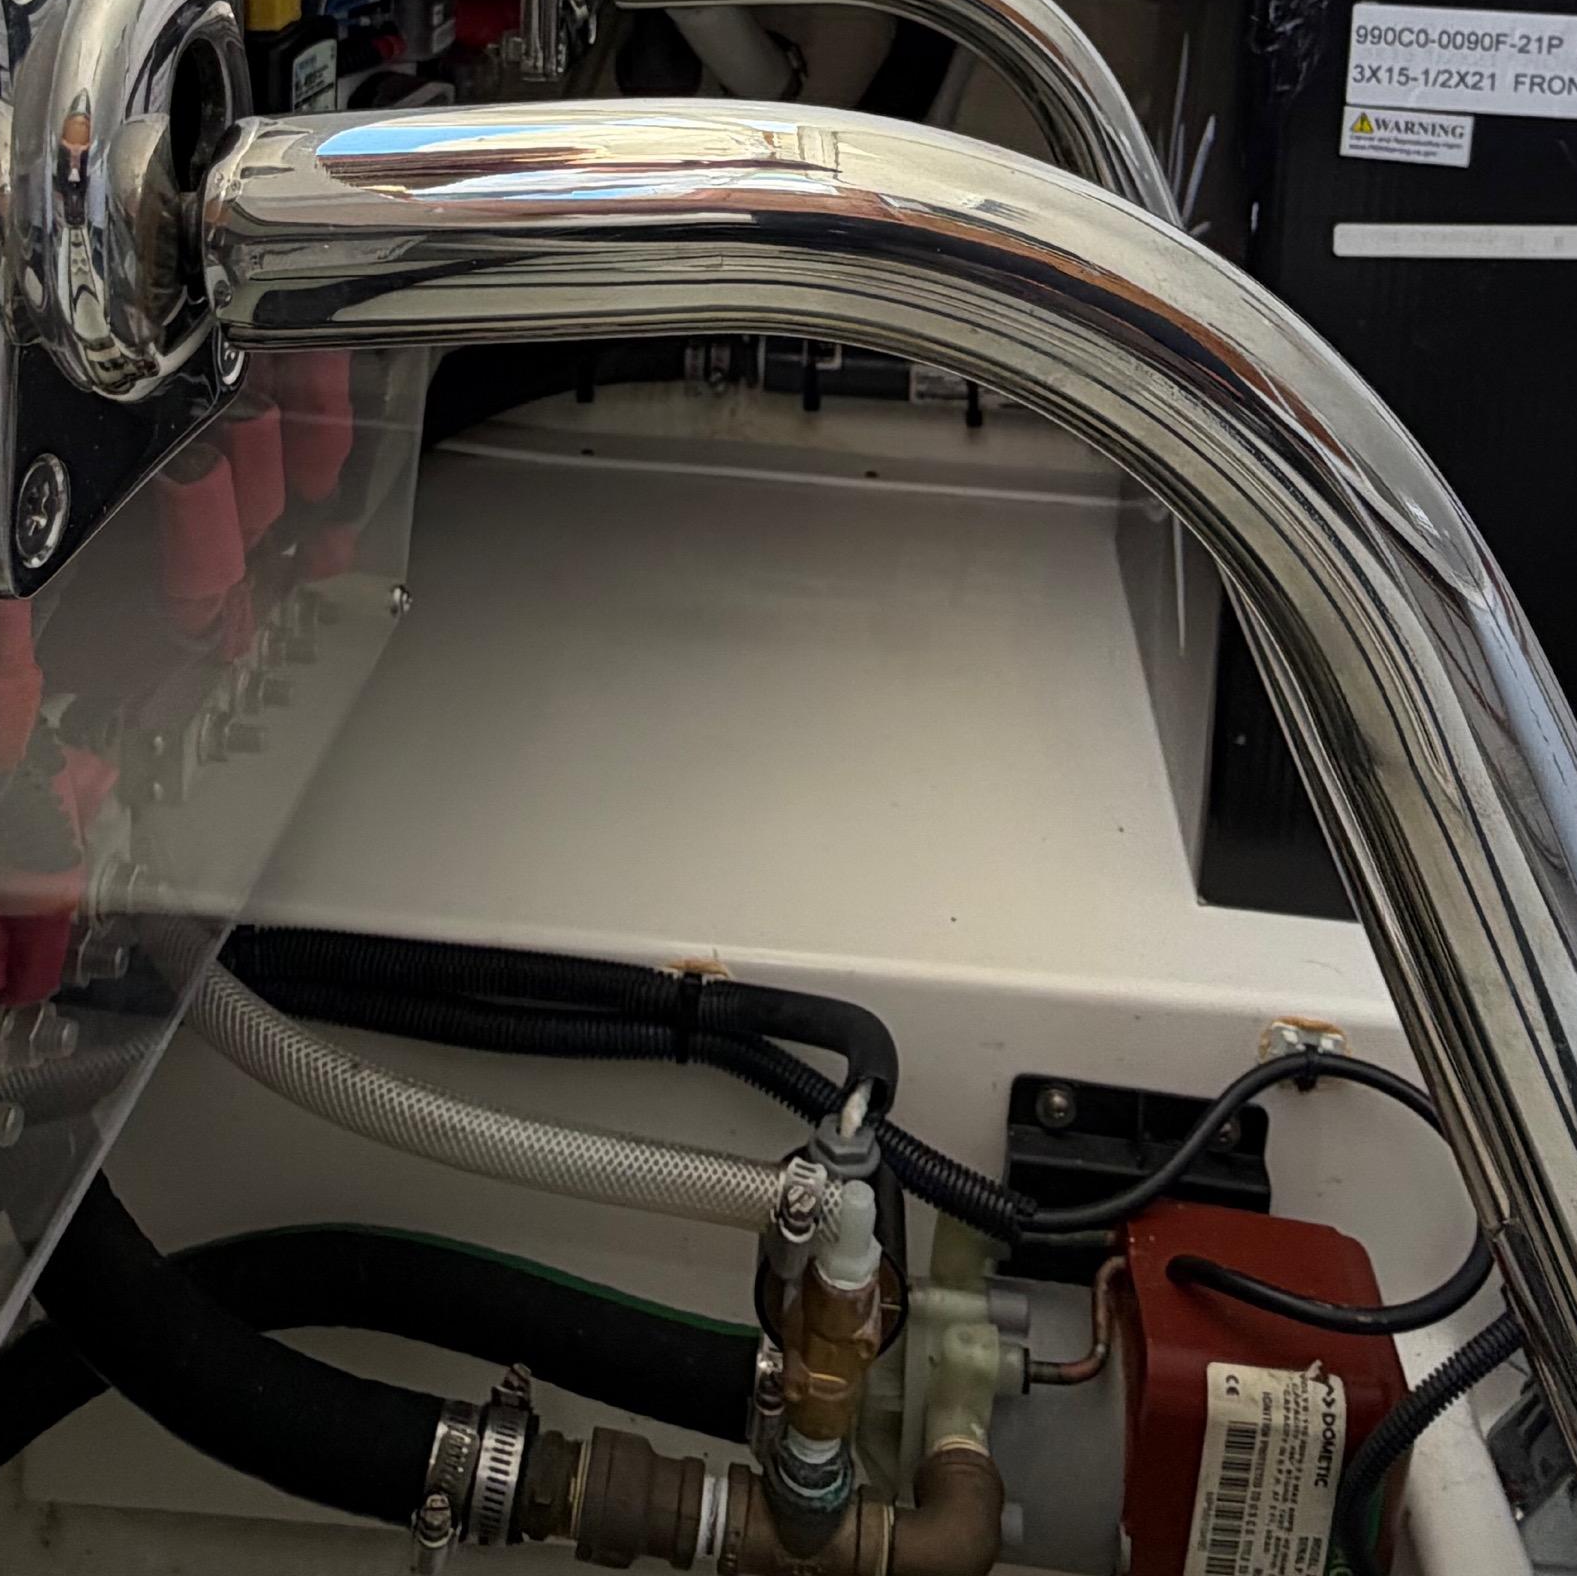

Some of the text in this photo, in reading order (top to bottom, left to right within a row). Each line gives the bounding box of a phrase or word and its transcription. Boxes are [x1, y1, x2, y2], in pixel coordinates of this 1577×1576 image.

[1355, 25, 1564, 55] 990C0-0090F-21P
[1352, 64, 1497, 92] 3X15-1/2X21
[1374, 118, 1465, 139] WARNING
[1314, 1412, 1336, 1488] DOMETIC
